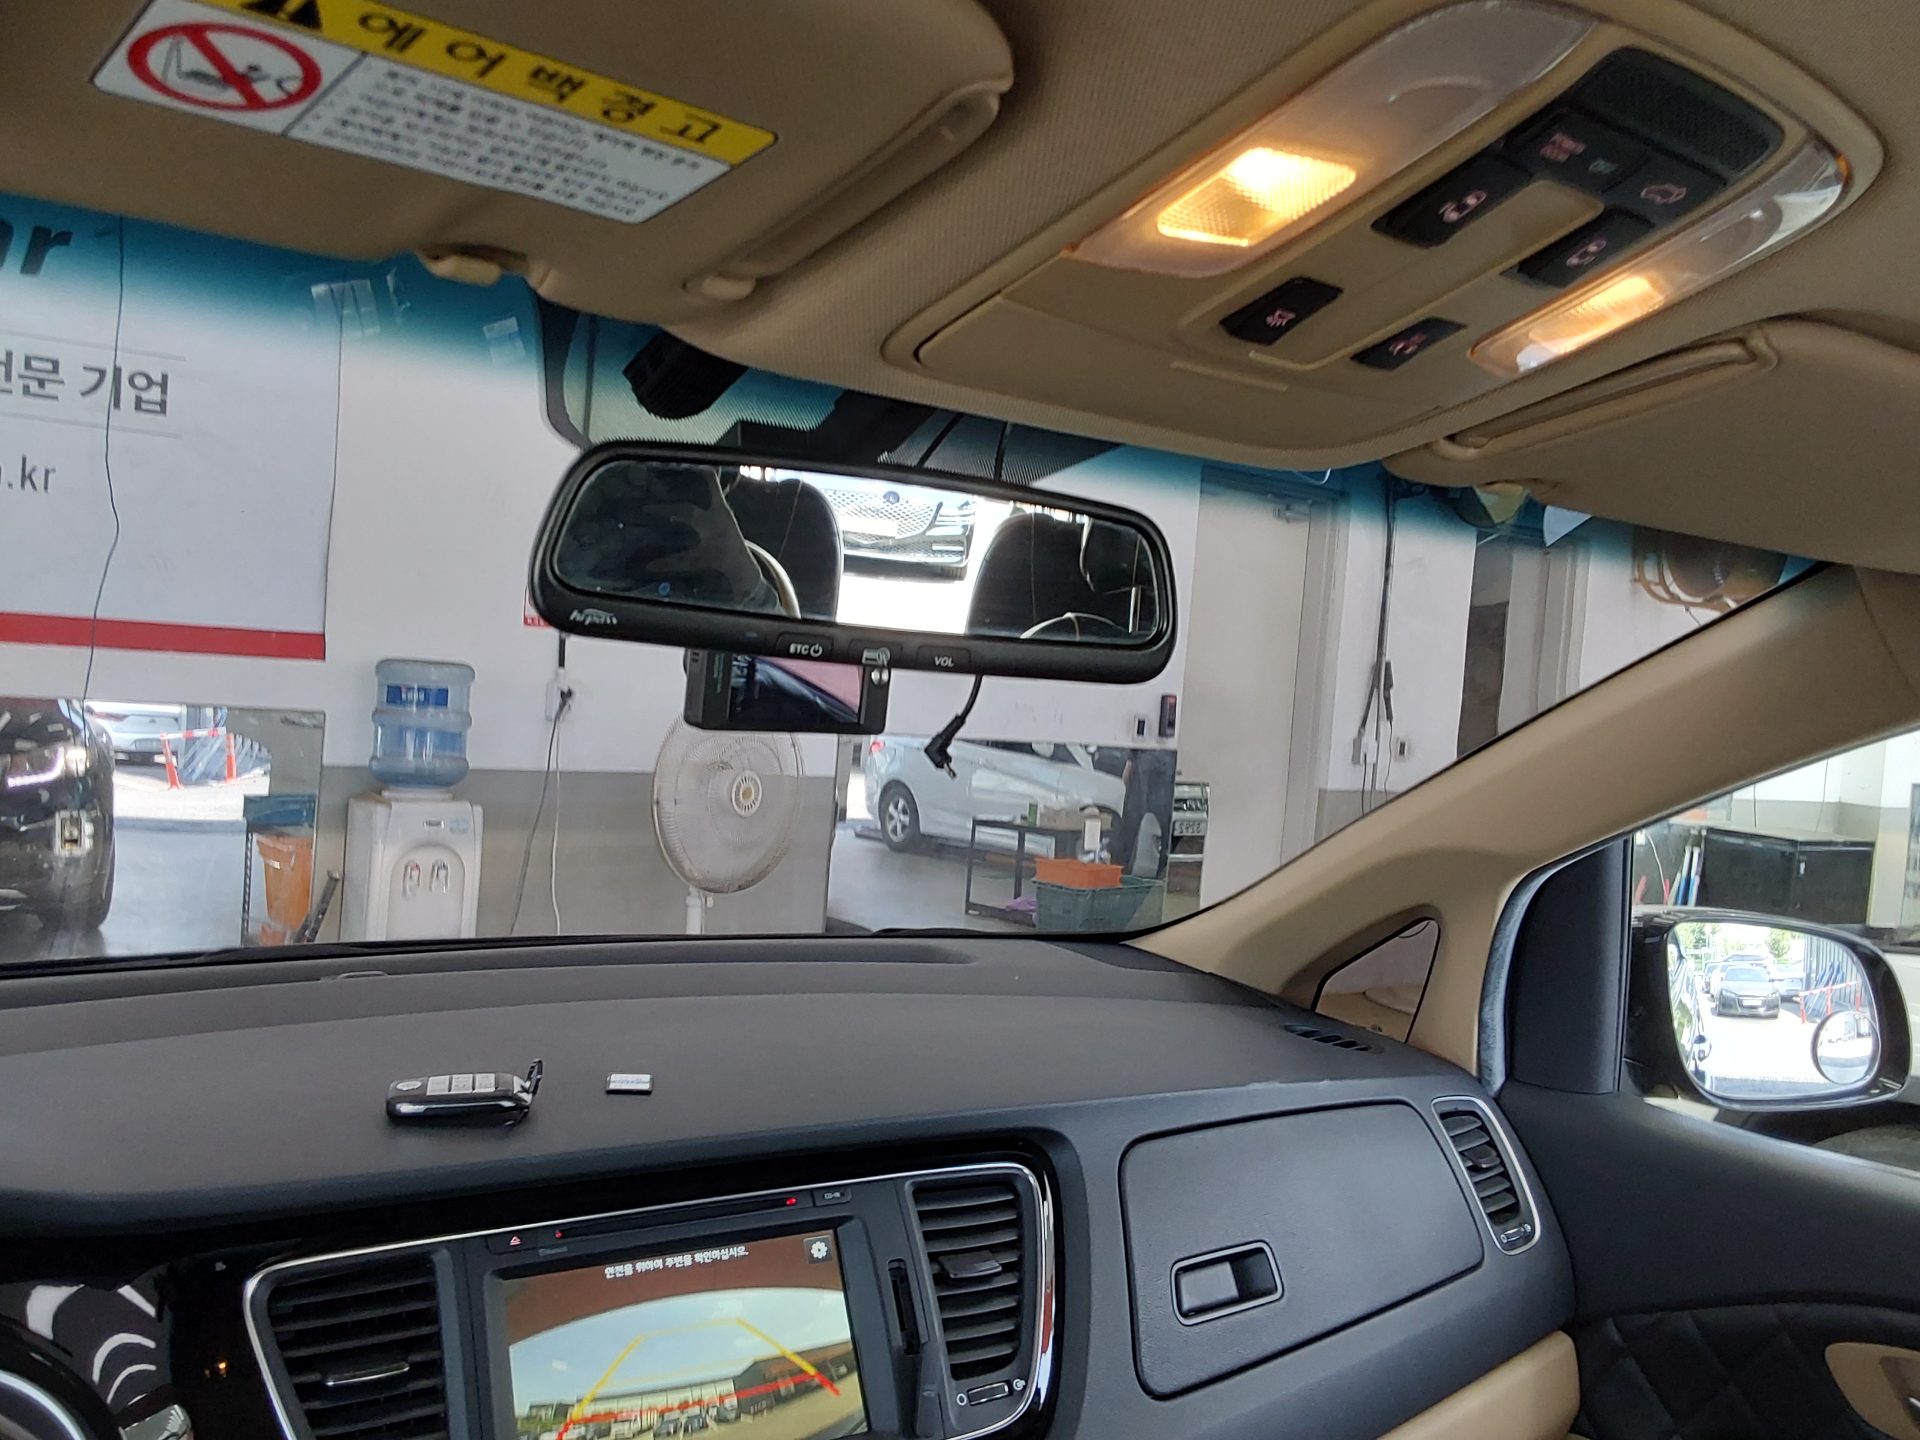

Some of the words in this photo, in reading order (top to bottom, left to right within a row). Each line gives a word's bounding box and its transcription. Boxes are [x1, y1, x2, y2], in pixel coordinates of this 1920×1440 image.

[80, 362, 169, 417] 기업
[0, 454, 57, 494] .kr
[789, 643, 810, 656] ETC
[934, 655, 955, 668] VOL
[665, 1254, 694, 1269] 주변을
